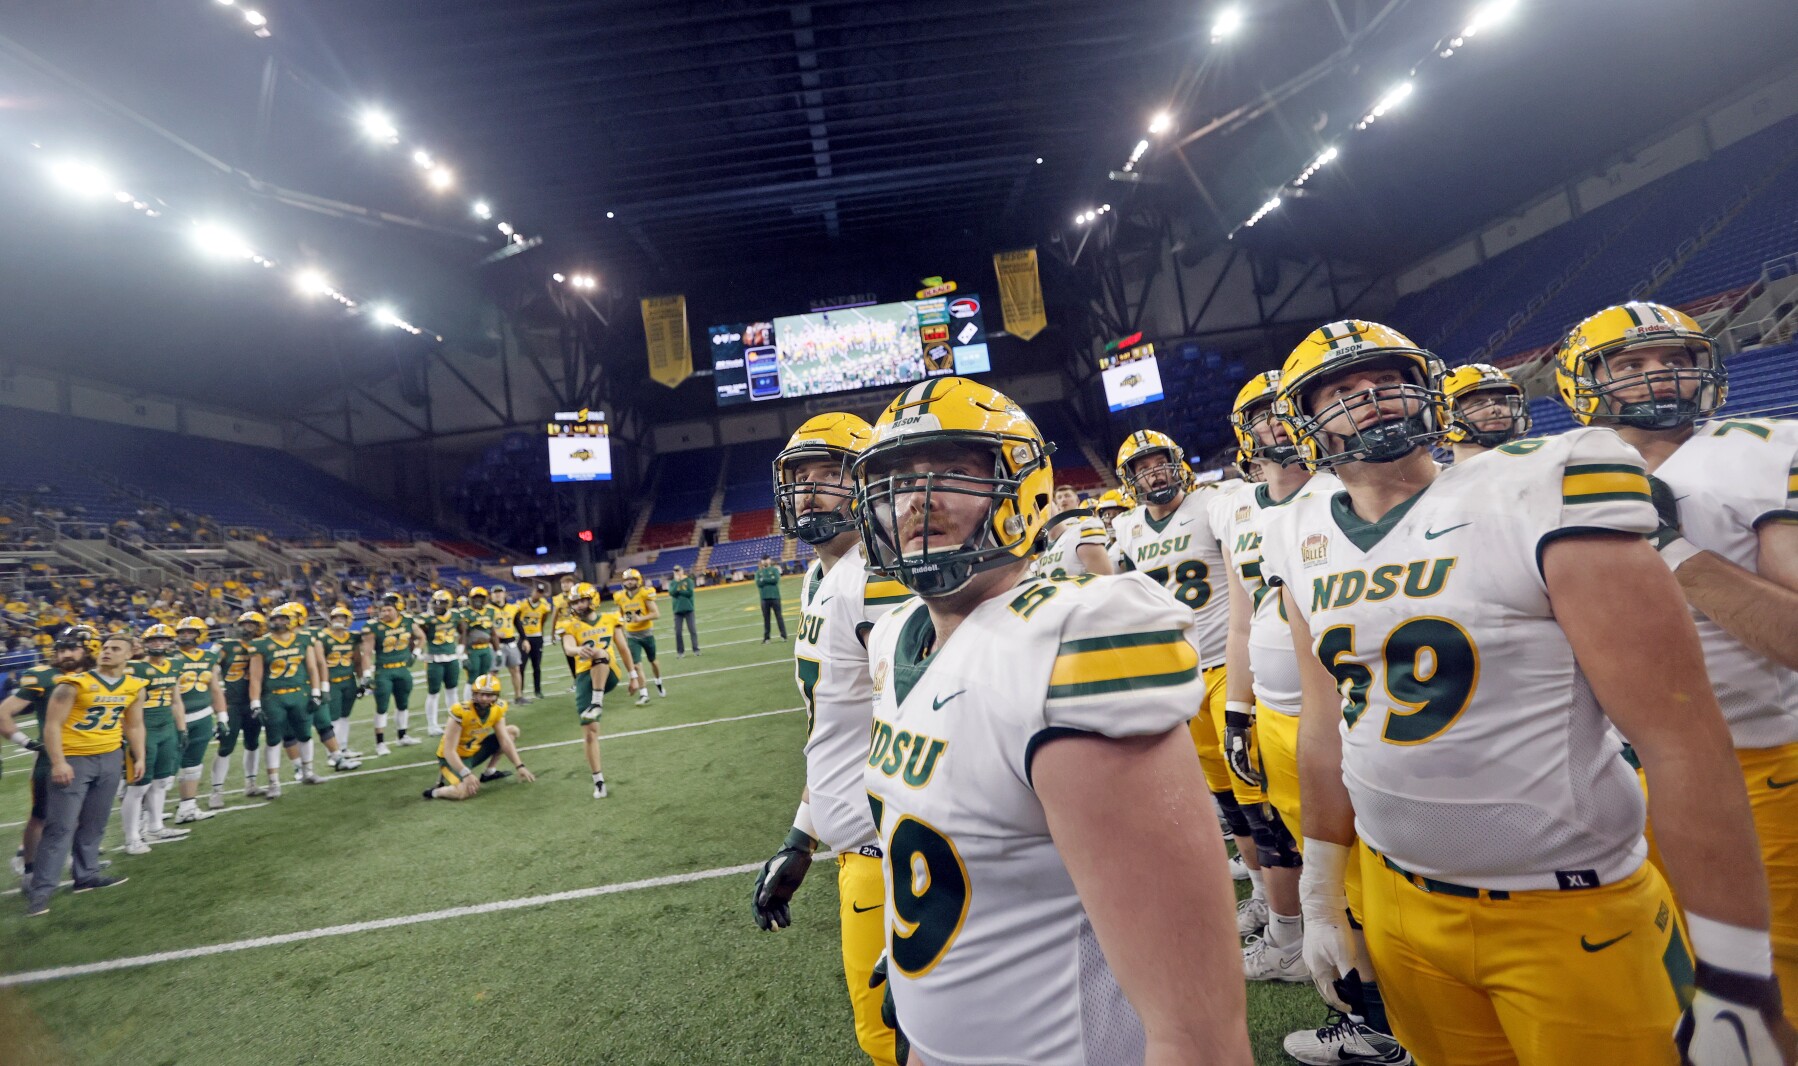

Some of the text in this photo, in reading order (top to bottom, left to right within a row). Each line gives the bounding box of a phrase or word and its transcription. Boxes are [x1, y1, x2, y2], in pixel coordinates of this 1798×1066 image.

[1335, 343, 1362, 356] BISON
[892, 416, 921, 429] BISON
[1136, 534, 1192, 563] NDSU
[1301, 543, 1327, 563] VALLEY
[911, 563, 938, 575] Riddell
[1310, 555, 1458, 614] NDSU
[582, 628, 607, 637] BISON
[224, 662, 250, 682] 5
[268, 655, 304, 679] 97
[1316, 615, 1481, 747] 69
[93, 695, 128, 703] BISON
[72, 705, 126, 732] 33
[862, 846, 880, 858] 2XL
[1565, 874, 1590, 888] XL
